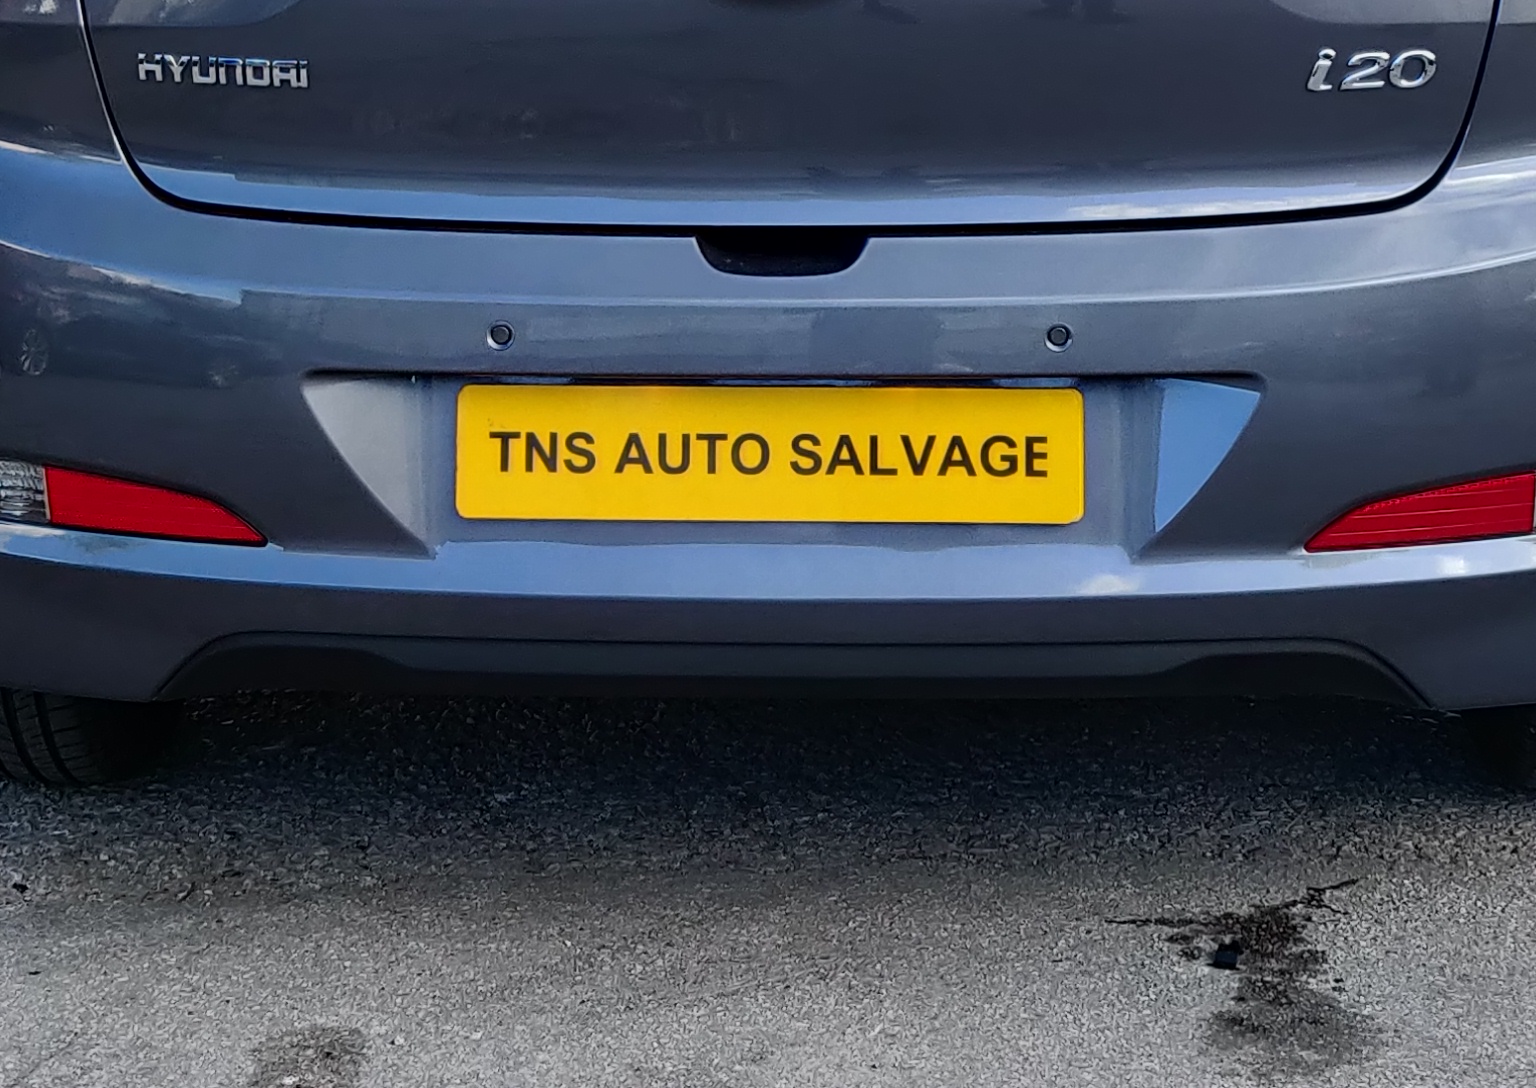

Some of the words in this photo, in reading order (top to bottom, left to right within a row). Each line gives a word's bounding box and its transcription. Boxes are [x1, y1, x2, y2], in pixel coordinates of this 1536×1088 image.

[137, 53, 309, 88] HYUNDAI
[1306, 48, 1437, 92] i20
[489, 430, 596, 474] TNS
[614, 432, 770, 476] AUTO
[789, 433, 1048, 478] SALVAGE
